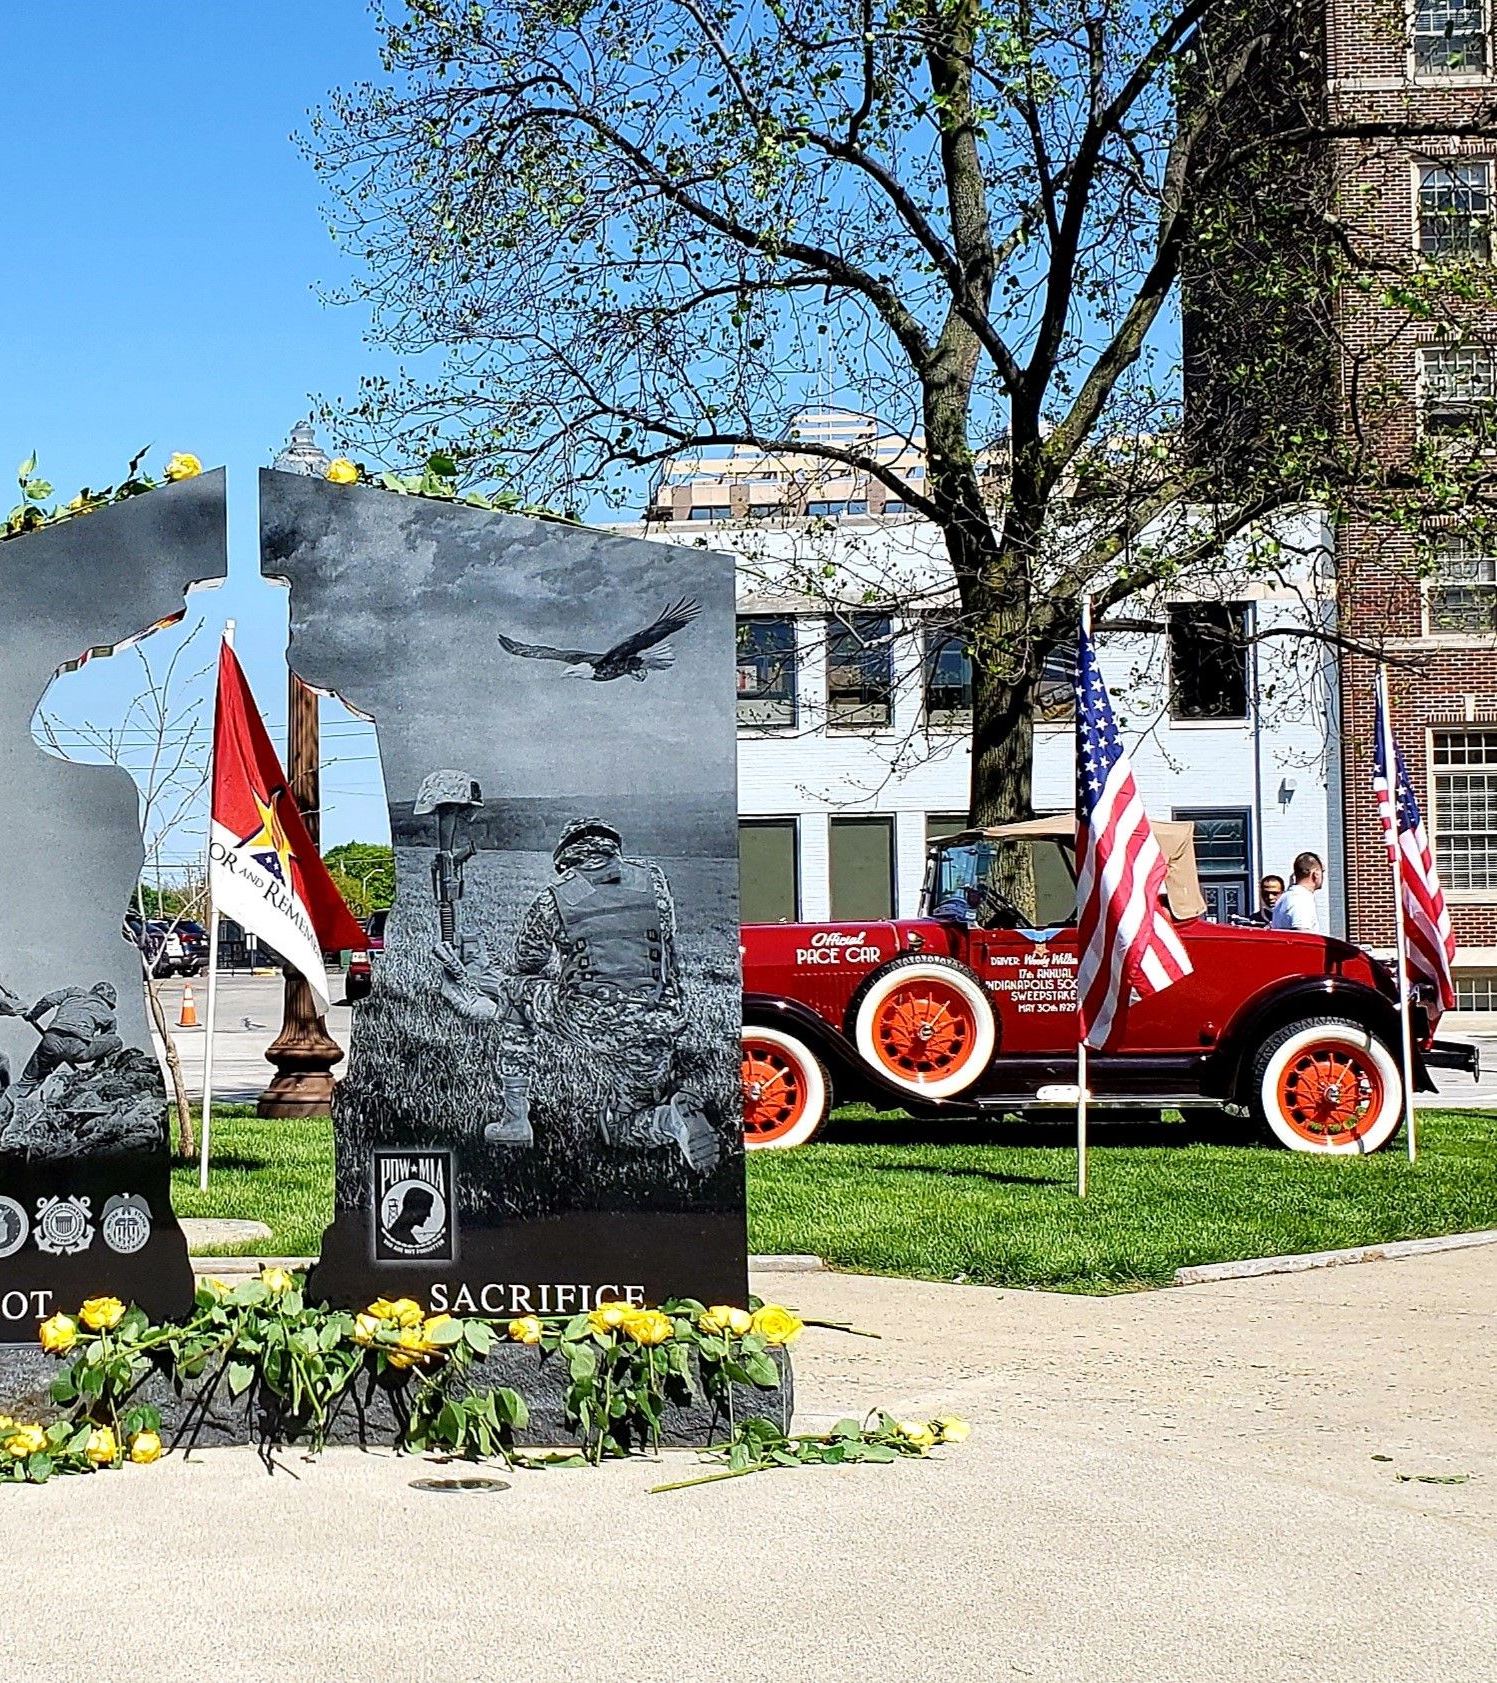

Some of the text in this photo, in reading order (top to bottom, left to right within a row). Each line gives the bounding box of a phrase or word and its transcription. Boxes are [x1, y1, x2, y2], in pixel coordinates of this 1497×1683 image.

[210, 842, 324, 966] OR AND REMEM
[811, 931, 866, 947] Official
[796, 946, 880, 965] PACE CAR
[1036, 968, 1074, 979] ANNUAL
[1011, 990, 1077, 1001] SWEEPSTAKE
[1018, 1002, 1077, 1013] MAY 30th 1929
[380, 1158, 445, 1198] POW MIA
[430, 1283, 647, 1313] SACRIFICE
